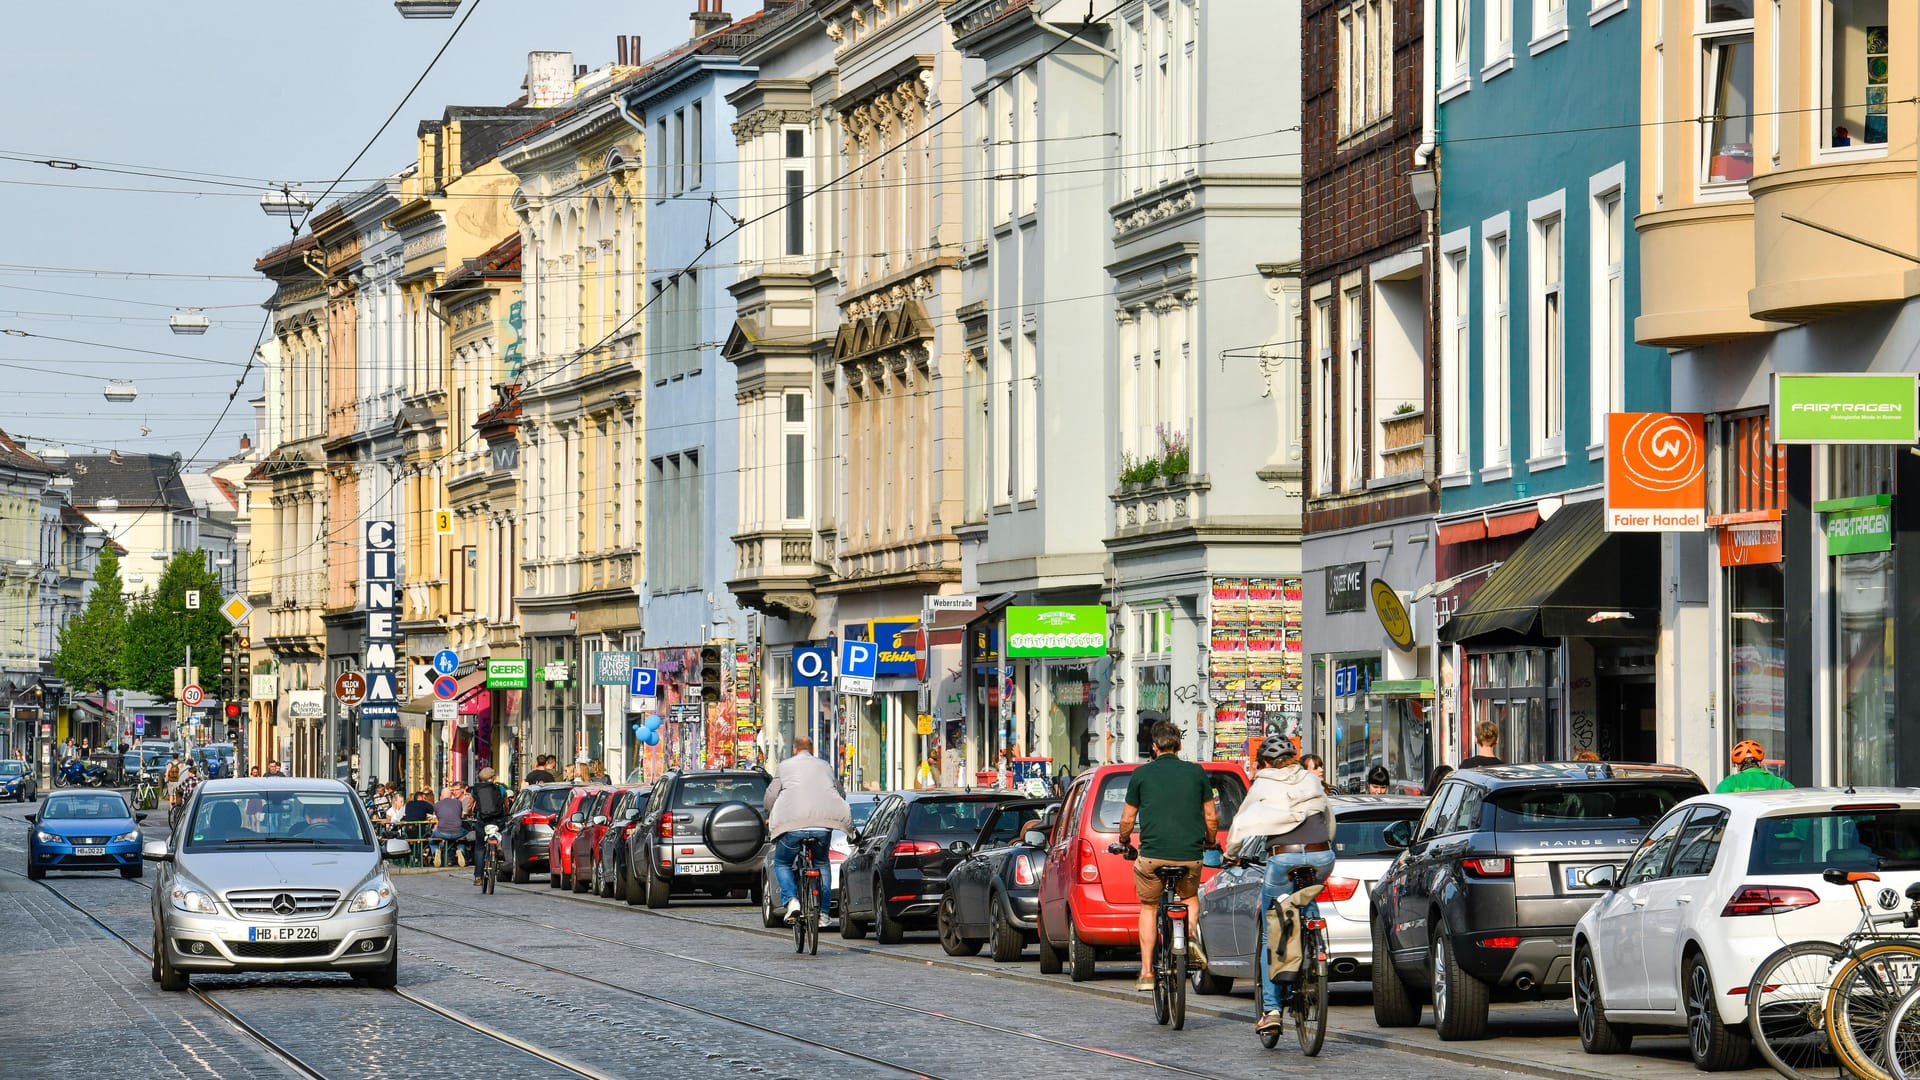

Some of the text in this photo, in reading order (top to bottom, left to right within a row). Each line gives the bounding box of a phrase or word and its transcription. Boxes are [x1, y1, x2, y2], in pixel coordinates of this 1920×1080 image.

[1792, 403, 1902, 412] FAIRTRAGEN
[440, 514, 447, 529] 3
[1614, 514, 1699, 526] Fairer Handel
[1828, 514, 1889, 538] FAIRTRAGEN
[1347, 571, 1361, 591] ME
[188, 593, 197, 607] E
[933, 599, 973, 607] Weberstraße
[366, 521, 396, 700] CINEMA
[849, 645, 869, 672] P
[878, 650, 916, 663] Tchibo
[490, 664, 524, 674] GEERS
[601, 661, 630, 670] UNGS
[490, 679, 524, 687] HÖRGERÄTE
[636, 671, 651, 692] P
[186, 690, 200, 701] 30
[1265, 703, 1281, 712] HOT
[1540, 839, 1603, 847] RANGE
[680, 865, 719, 873] HB LH 118
[256, 927, 318, 940] HB EP 226
